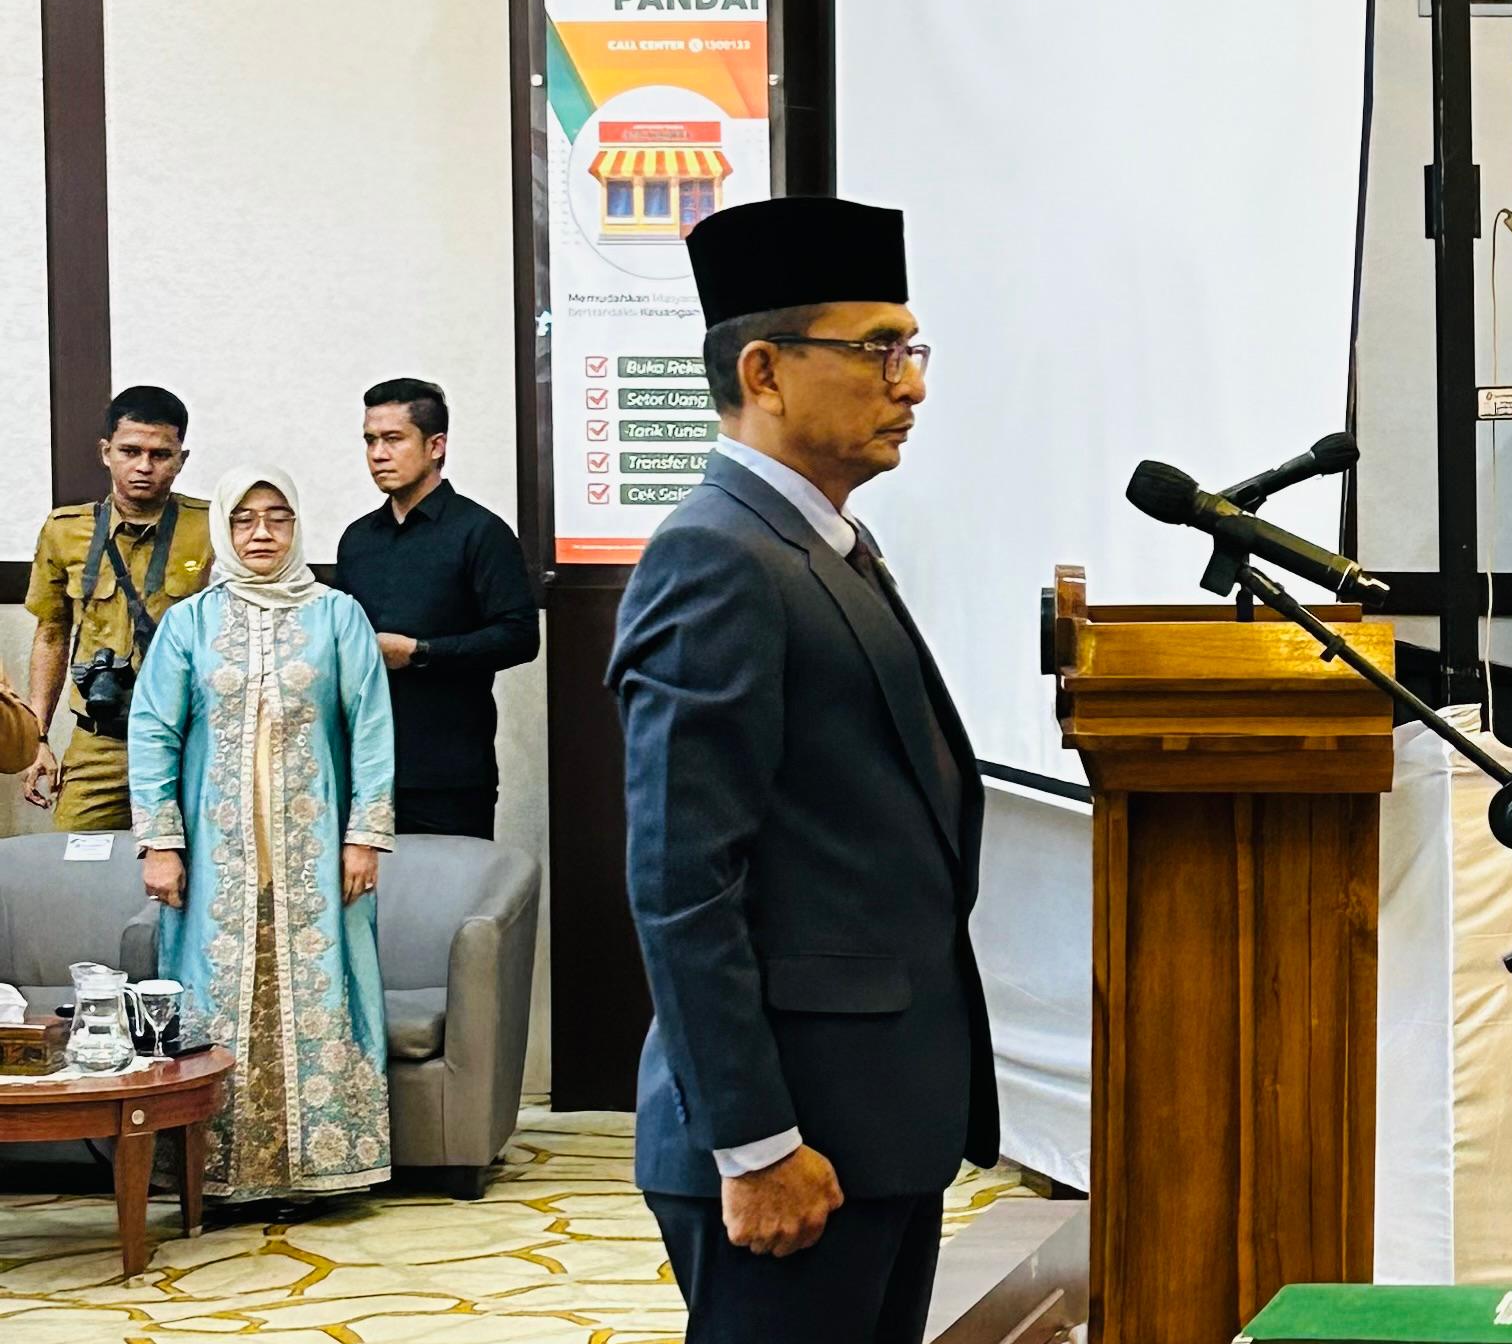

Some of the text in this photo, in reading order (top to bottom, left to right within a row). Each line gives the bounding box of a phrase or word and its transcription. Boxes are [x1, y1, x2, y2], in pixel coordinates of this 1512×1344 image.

[607, 39, 638, 51] CALL
[639, 39, 685, 51] CENTER
[568, 293, 650, 304] Memudahkan
[626, 360, 664, 374] Buka
[627, 392, 708, 409] Setor Uang
[666, 423, 708, 438] Tunai
[629, 455, 688, 469] Transfer
[628, 487, 656, 501] Cek
